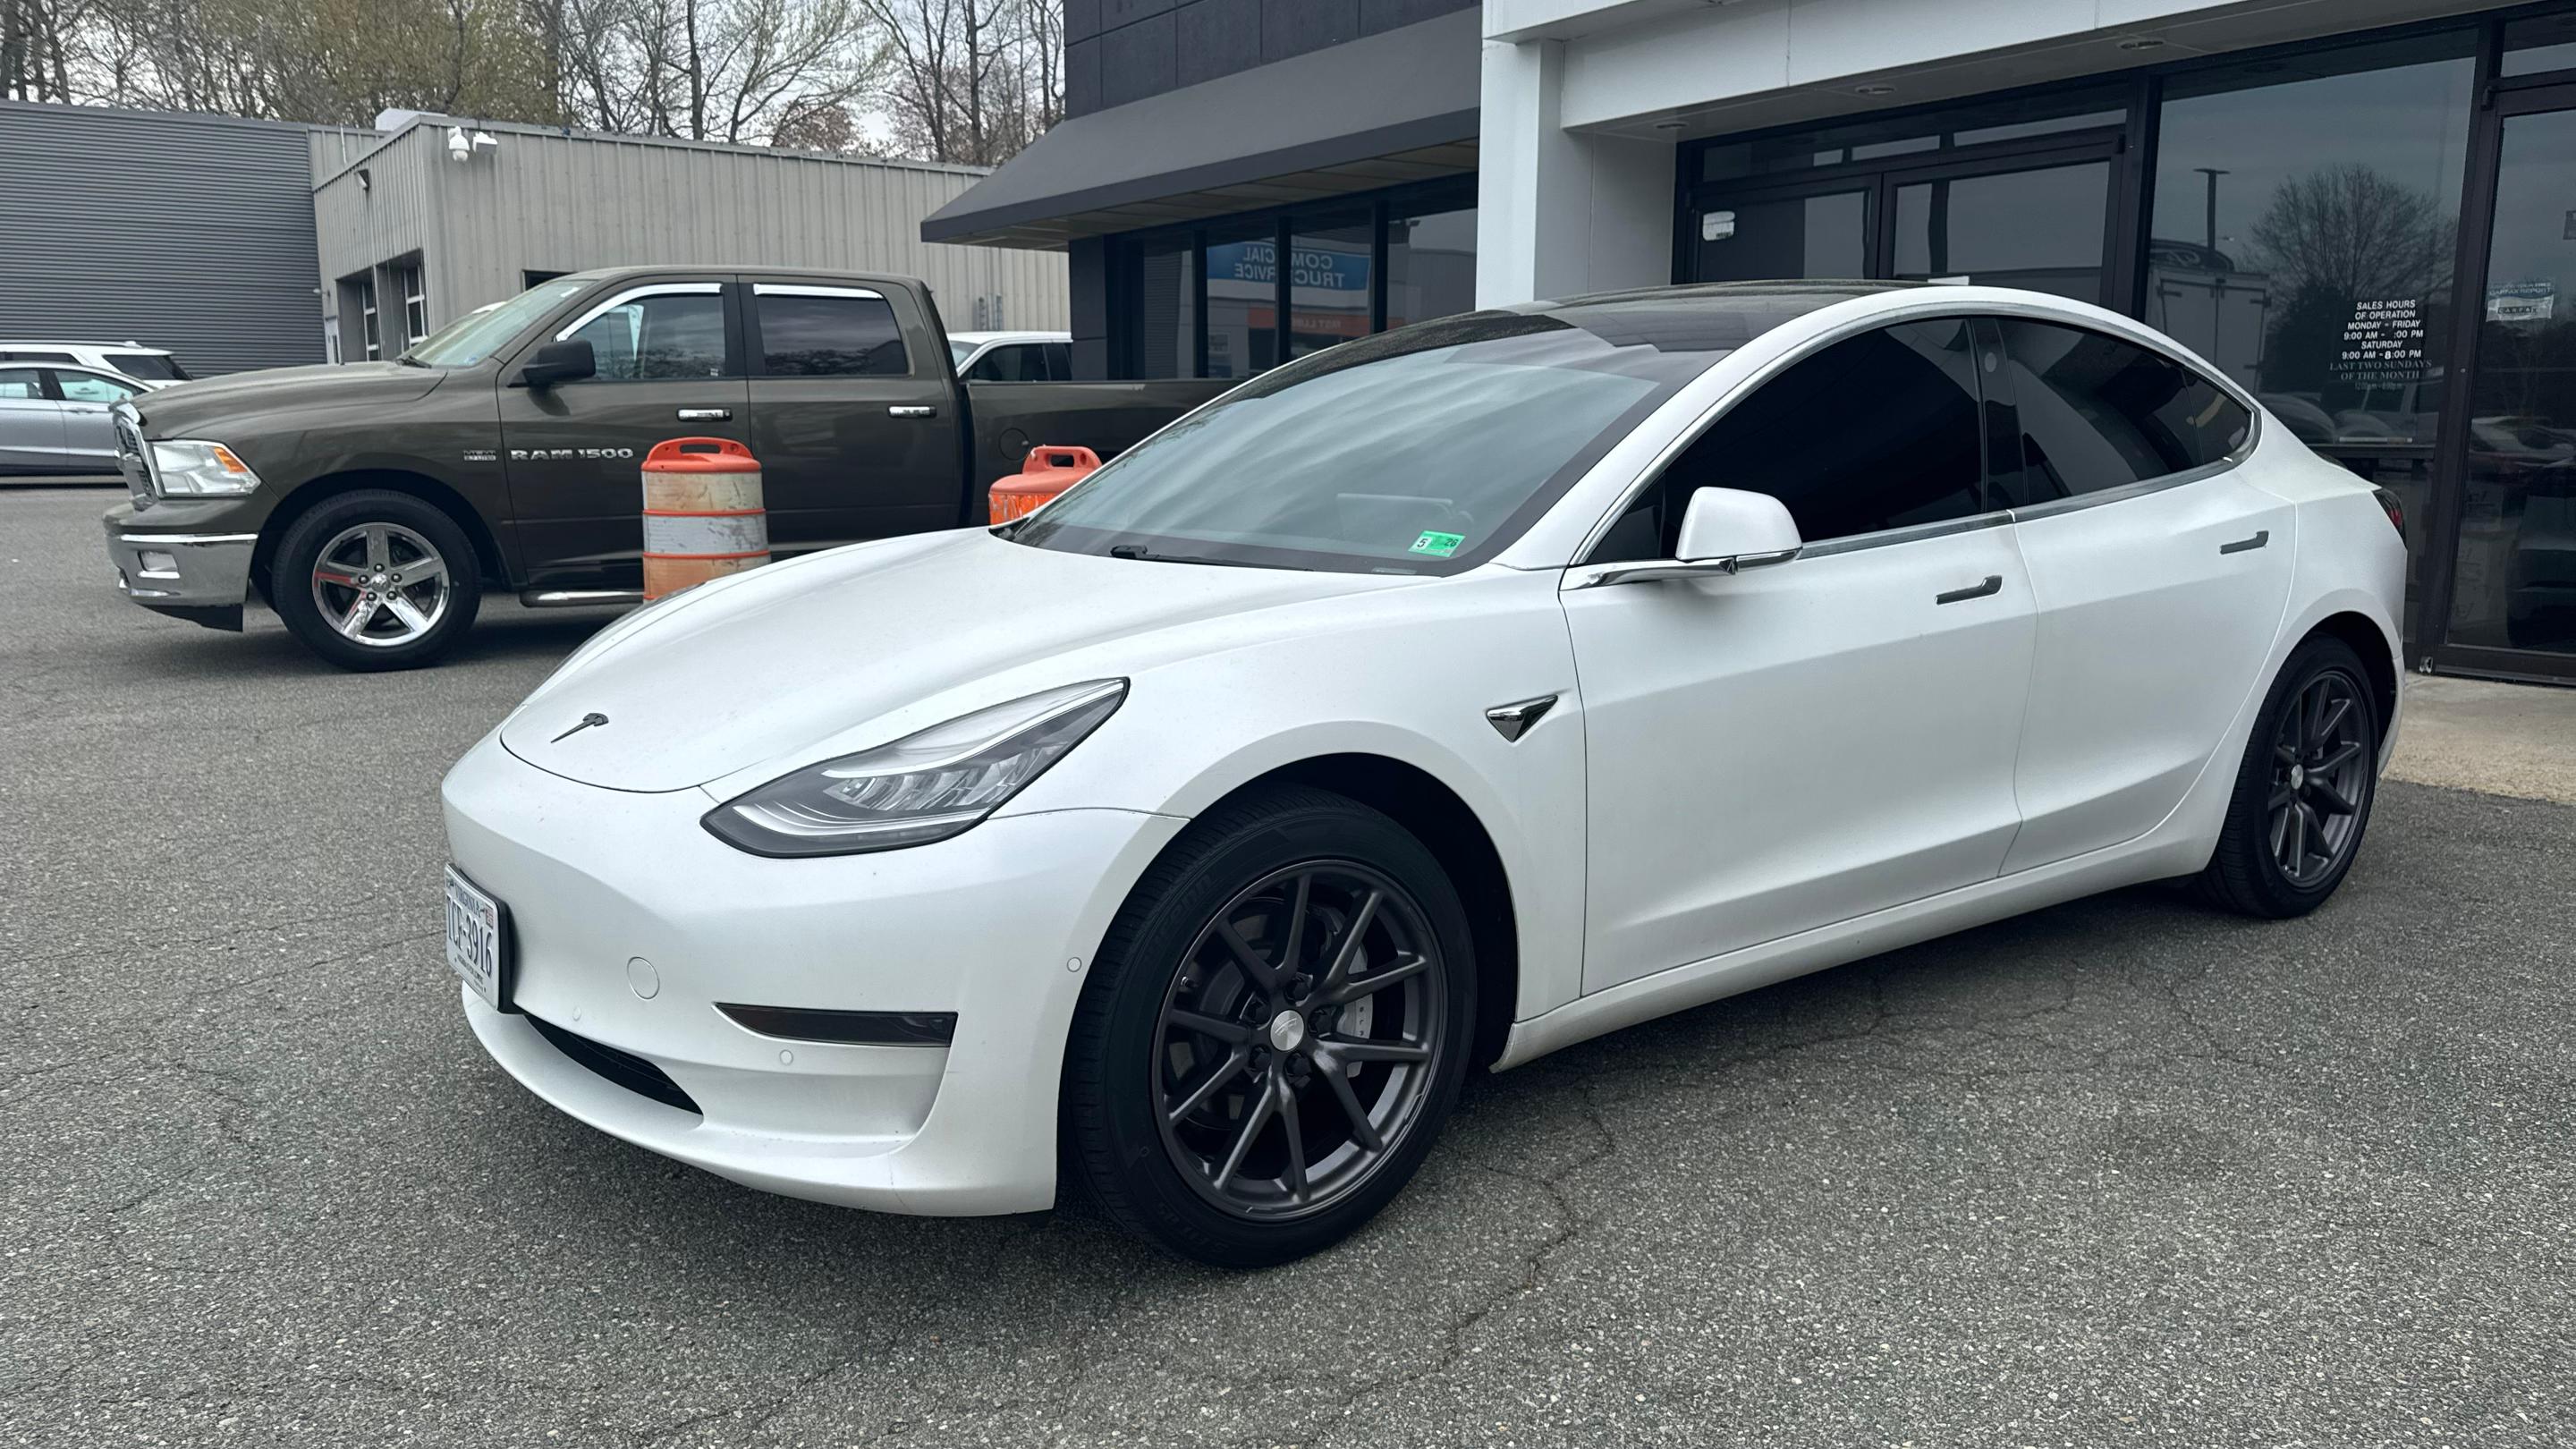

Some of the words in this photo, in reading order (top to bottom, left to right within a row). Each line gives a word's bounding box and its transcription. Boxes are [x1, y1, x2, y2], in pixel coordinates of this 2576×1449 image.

[2356, 301, 2384, 310] SALES
[2385, 299, 2416, 309] HOURS
[2354, 311, 2367, 320] OF
[2368, 309, 2416, 320] OPERATION
[2347, 321, 2382, 330] MONDAY
[2392, 319, 2421, 329] FRIDAY
[2343, 331, 2362, 341] 9:00
[2364, 331, 2378, 339] AM
[2411, 329, 2424, 338] PM
[2361, 340, 2403, 350] SATURDAY
[2342, 351, 2360, 360] 9:00
[2362, 351, 2377, 359] AM
[2409, 350, 2422, 358] PM
[2329, 361, 2355, 371] LAST
[2358, 360, 2382, 370] TWO
[2383, 360, 2433, 369] SUNDAYS
[2340, 371, 2354, 380] OF
[2357, 371, 2378, 380] THE
[2381, 370, 2420, 380] MONTH
[510, 449, 572, 461] RAM
[578, 447, 633, 459] 1500
[1417, 538, 1428, 548] 5
